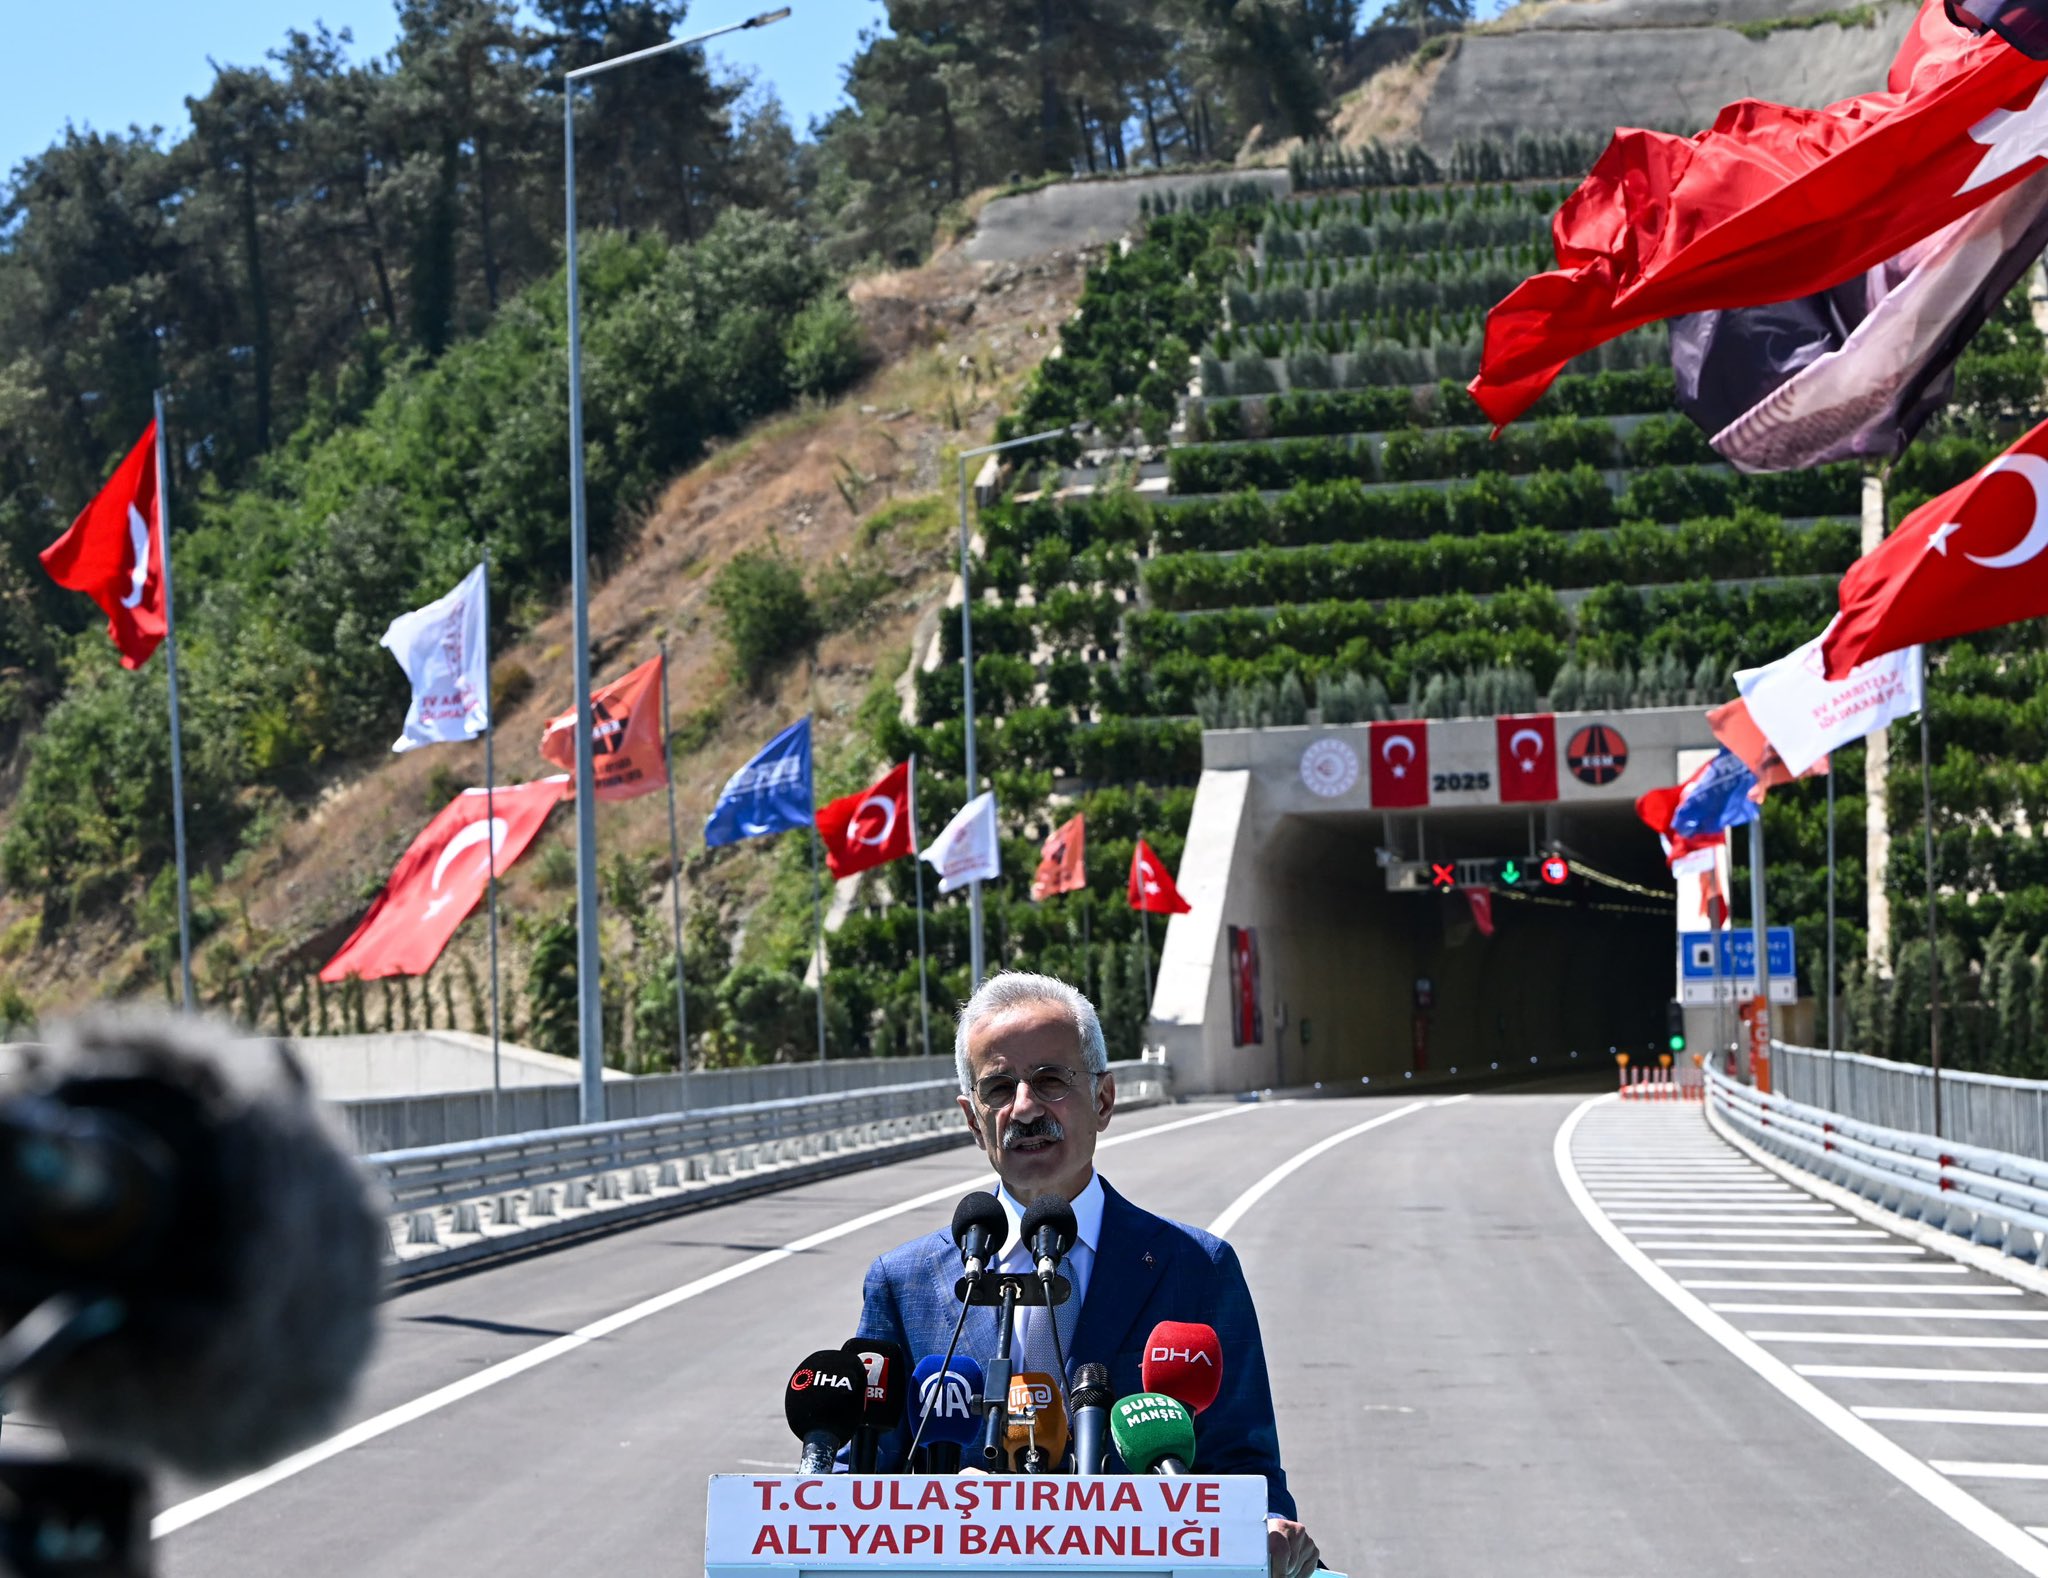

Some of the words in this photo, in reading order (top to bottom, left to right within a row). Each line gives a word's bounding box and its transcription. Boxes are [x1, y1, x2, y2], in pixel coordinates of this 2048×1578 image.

[1433, 772, 1491, 792] 2025
[1151, 1347, 1213, 1367] DHA
[813, 1370, 853, 1391] İHA
[919, 1381, 970, 1419] AA
[1120, 1396, 1180, 1416] BURSA
[1127, 1409, 1183, 1428] MANŞET
[753, 1480, 837, 1511] T.C.
[852, 1480, 1143, 1520] ULAŞTIRMA
[1159, 1482, 1221, 1512] VE
[751, 1524, 943, 1555] ALTYAPI
[959, 1519, 1220, 1557] BAKANLIĞI
